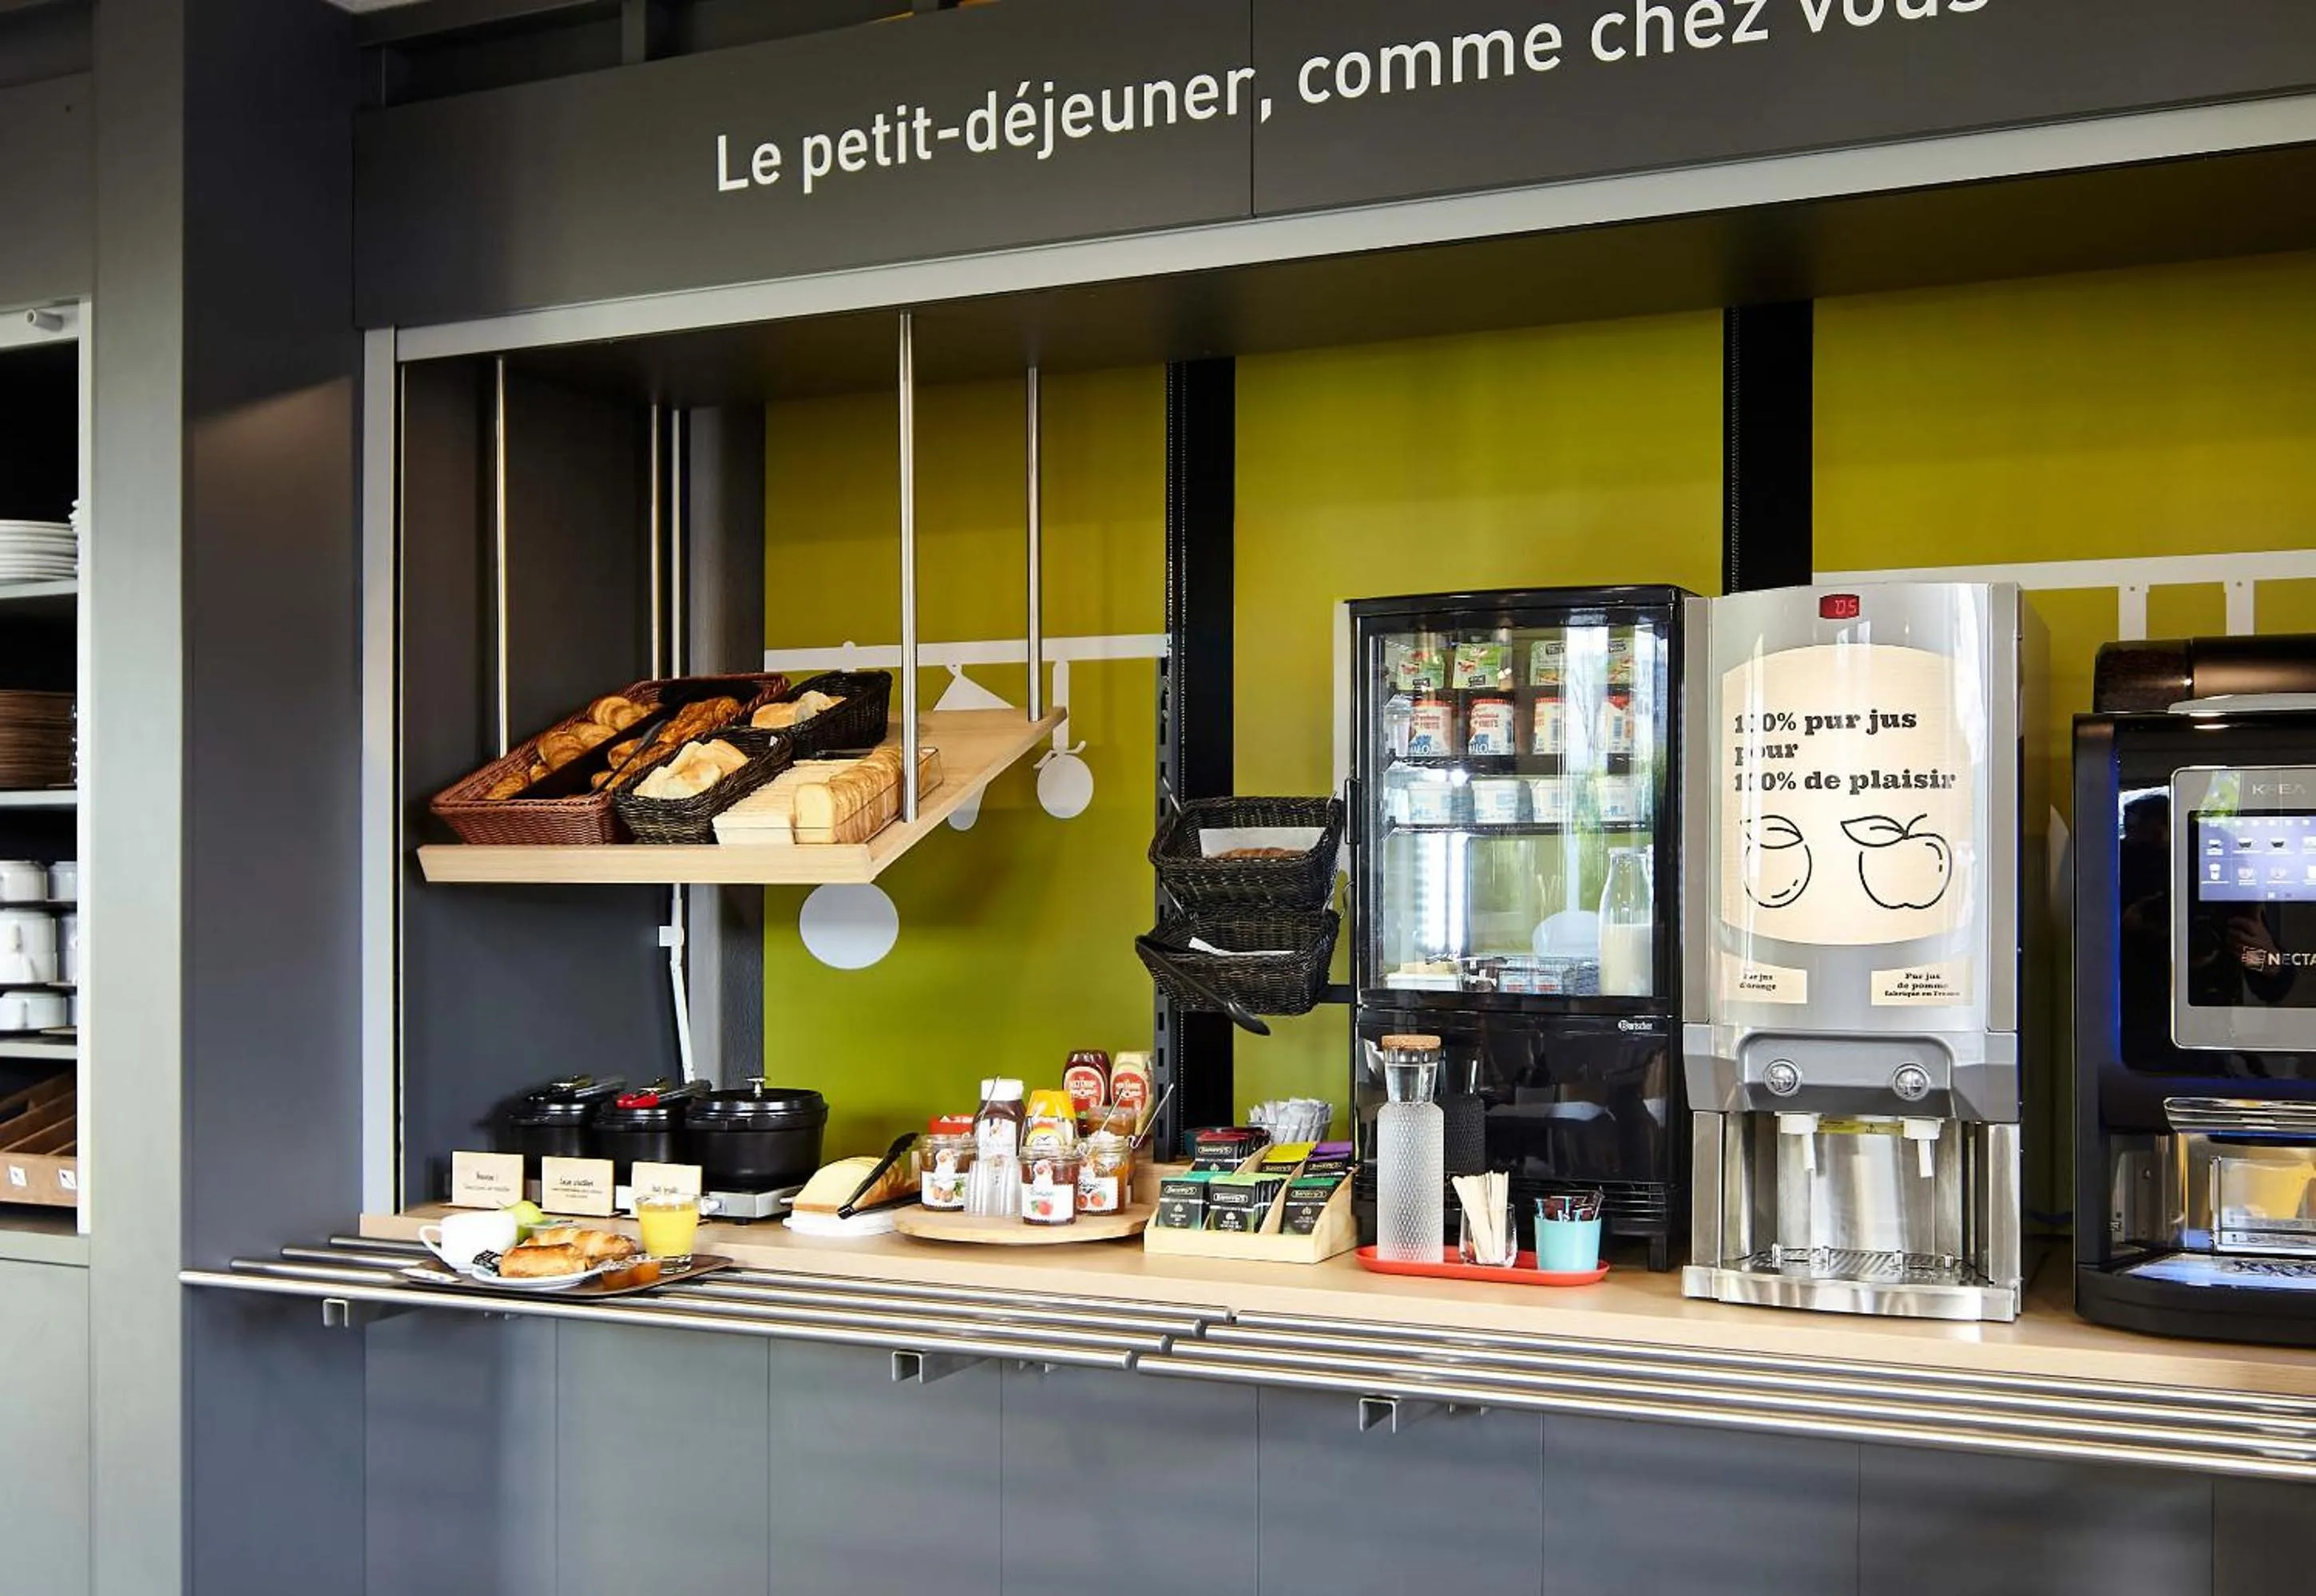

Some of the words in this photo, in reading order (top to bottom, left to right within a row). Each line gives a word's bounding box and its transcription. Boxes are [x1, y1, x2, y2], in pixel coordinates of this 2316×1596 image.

[717, 134, 782, 192] Le
[803, 66, 1272, 194] petit-déjeuner,
[1298, 23, 1562, 104] comme
[1591, 0, 1769, 61] chez
[1801, 0, 1989, 33] vo
[1735, 712, 1797, 734] 10%
[1804, 714, 1861, 735] pur
[1866, 708, 1917, 735] jus
[1735, 743, 1798, 766] pur
[1735, 771, 1797, 791] 10%
[1804, 770, 1841, 790] de
[1849, 768, 1956, 795] plaisir
[2252, 783, 2306, 795] KEA
